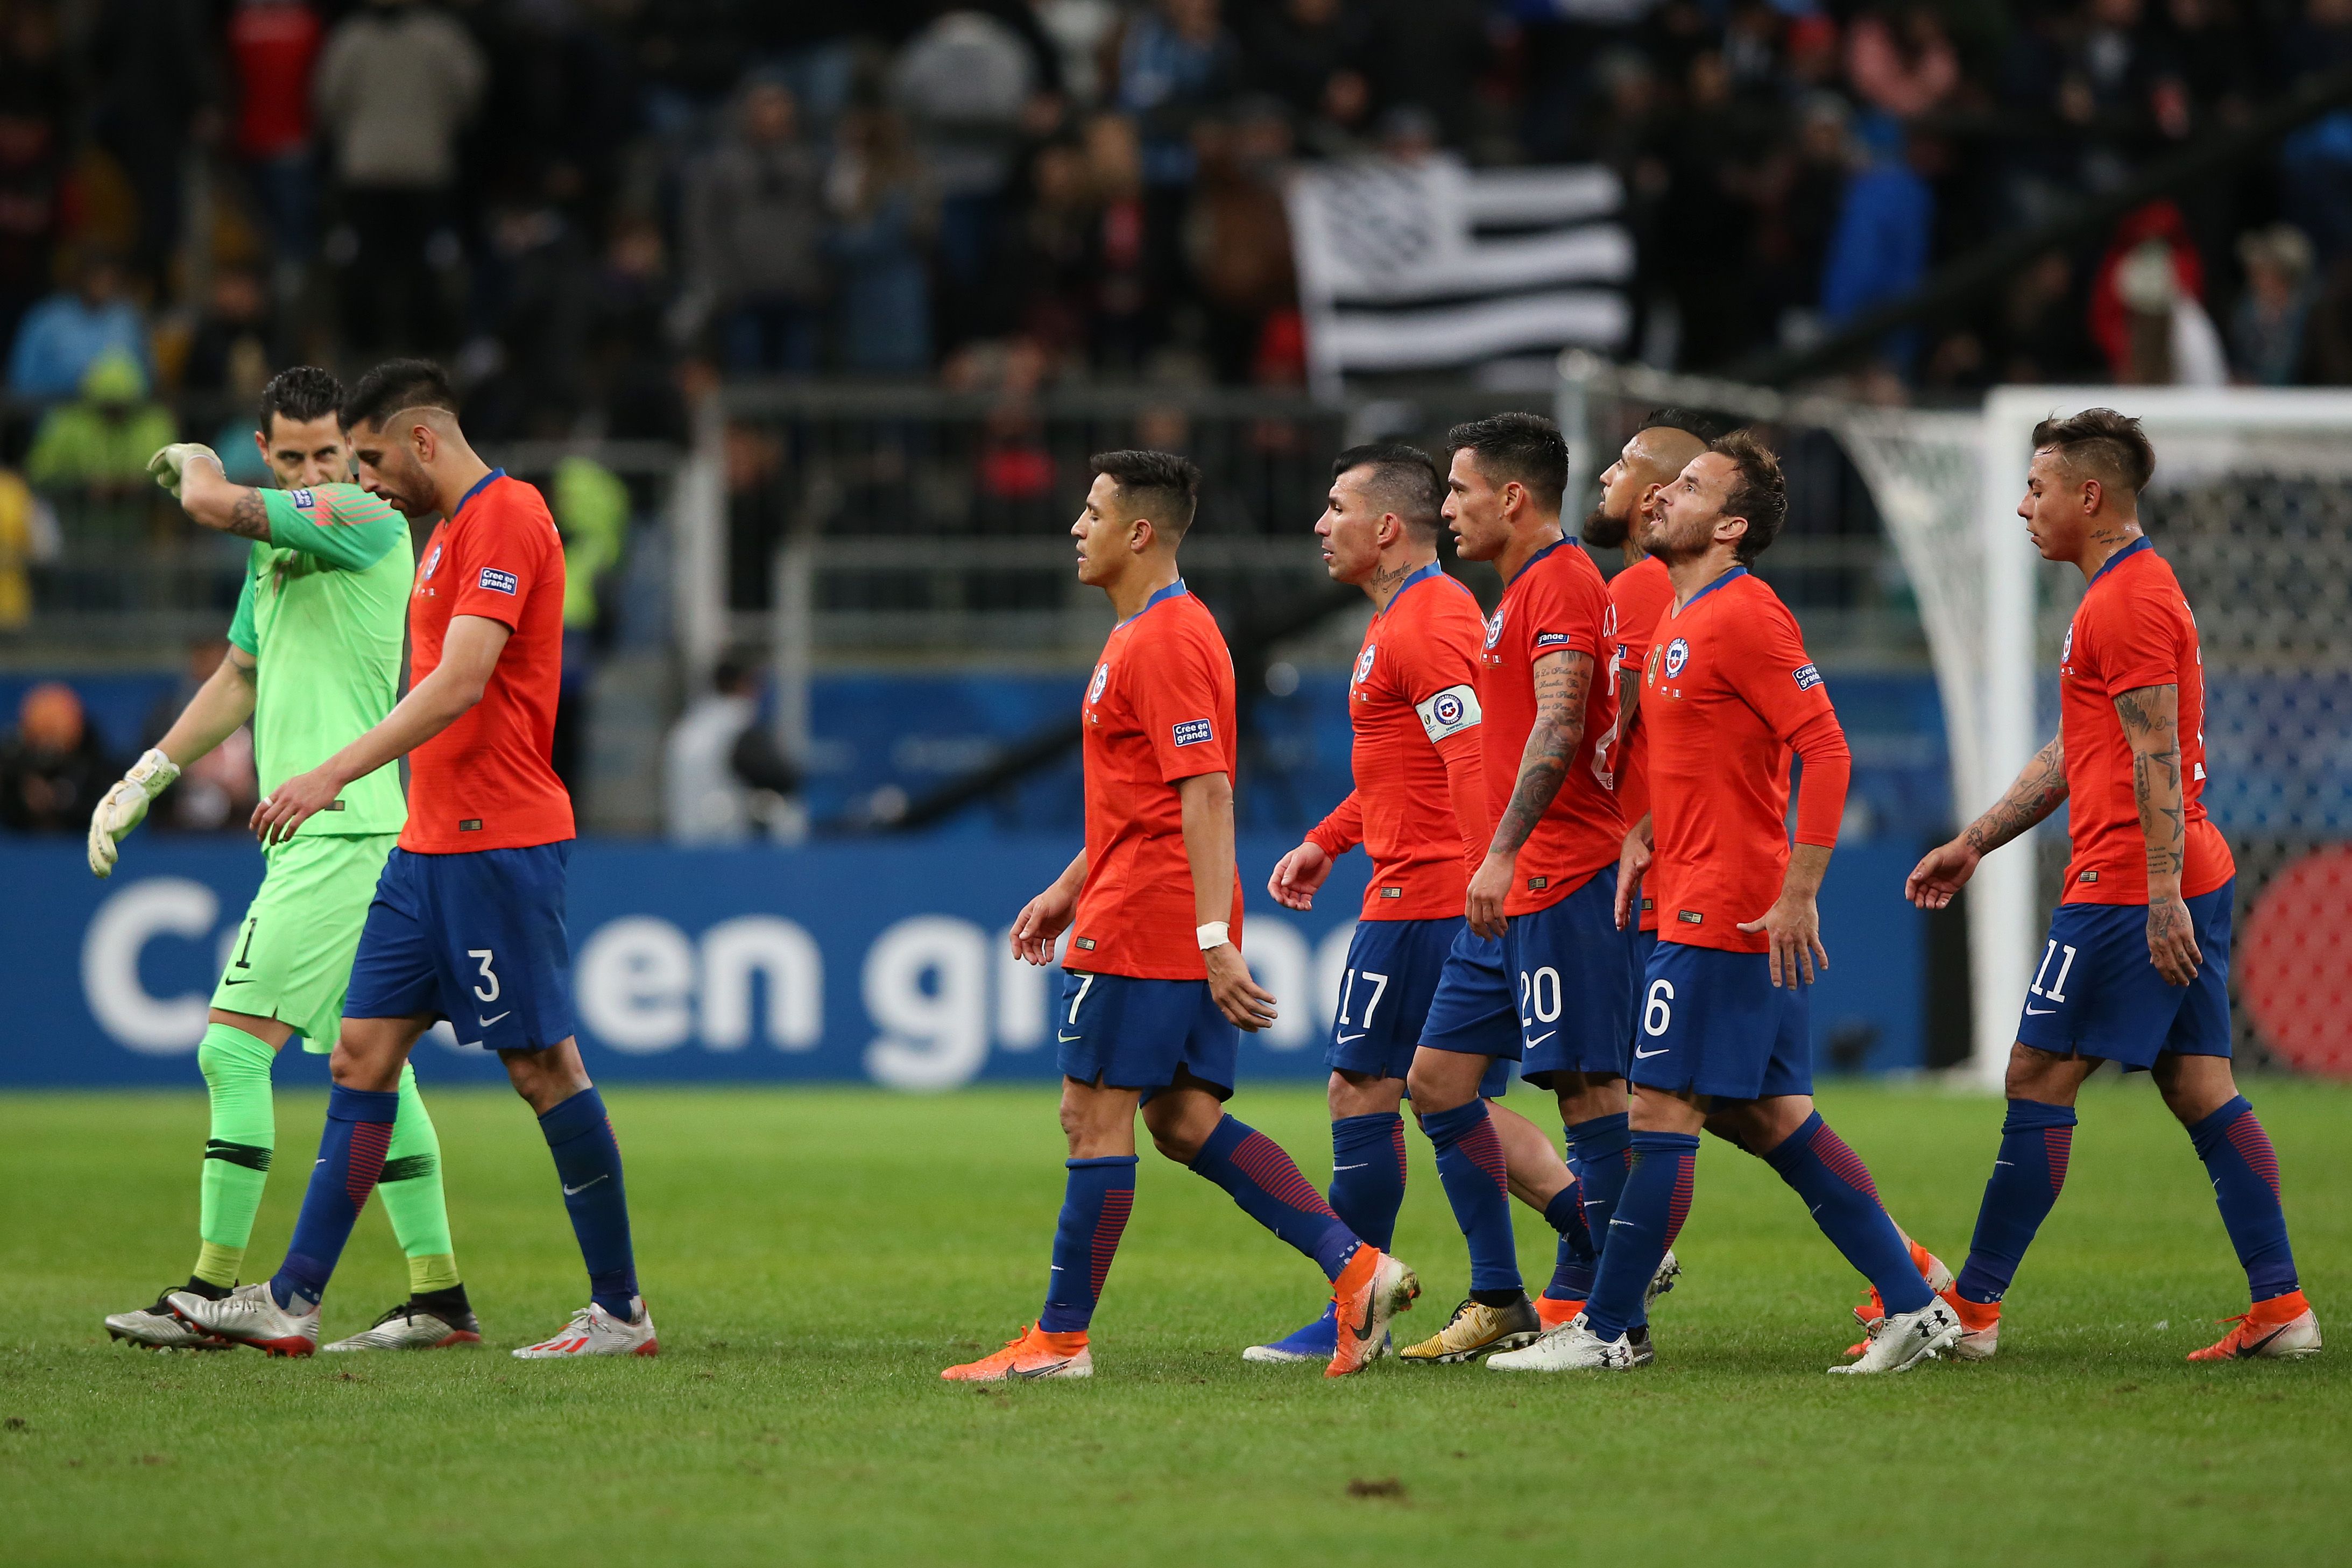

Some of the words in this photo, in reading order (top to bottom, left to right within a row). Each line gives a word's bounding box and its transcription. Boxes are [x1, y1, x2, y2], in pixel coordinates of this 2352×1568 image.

[481, 578, 513, 590] grande
[483, 570, 504, 581] Cree
[505, 576, 515, 584] en
[1175, 724, 1196, 734] Cree
[1177, 730, 1208, 744] grande
[235, 917, 258, 969] 1
[468, 949, 500, 1002] 3
[574, 913, 827, 1056] en
[2030, 938, 2077, 1003] 11
[1068, 973, 1094, 1025] 7
[1339, 968, 1388, 1029] 17
[1521, 966, 1562, 1028] 20
[1644, 979, 1675, 1036] 6
